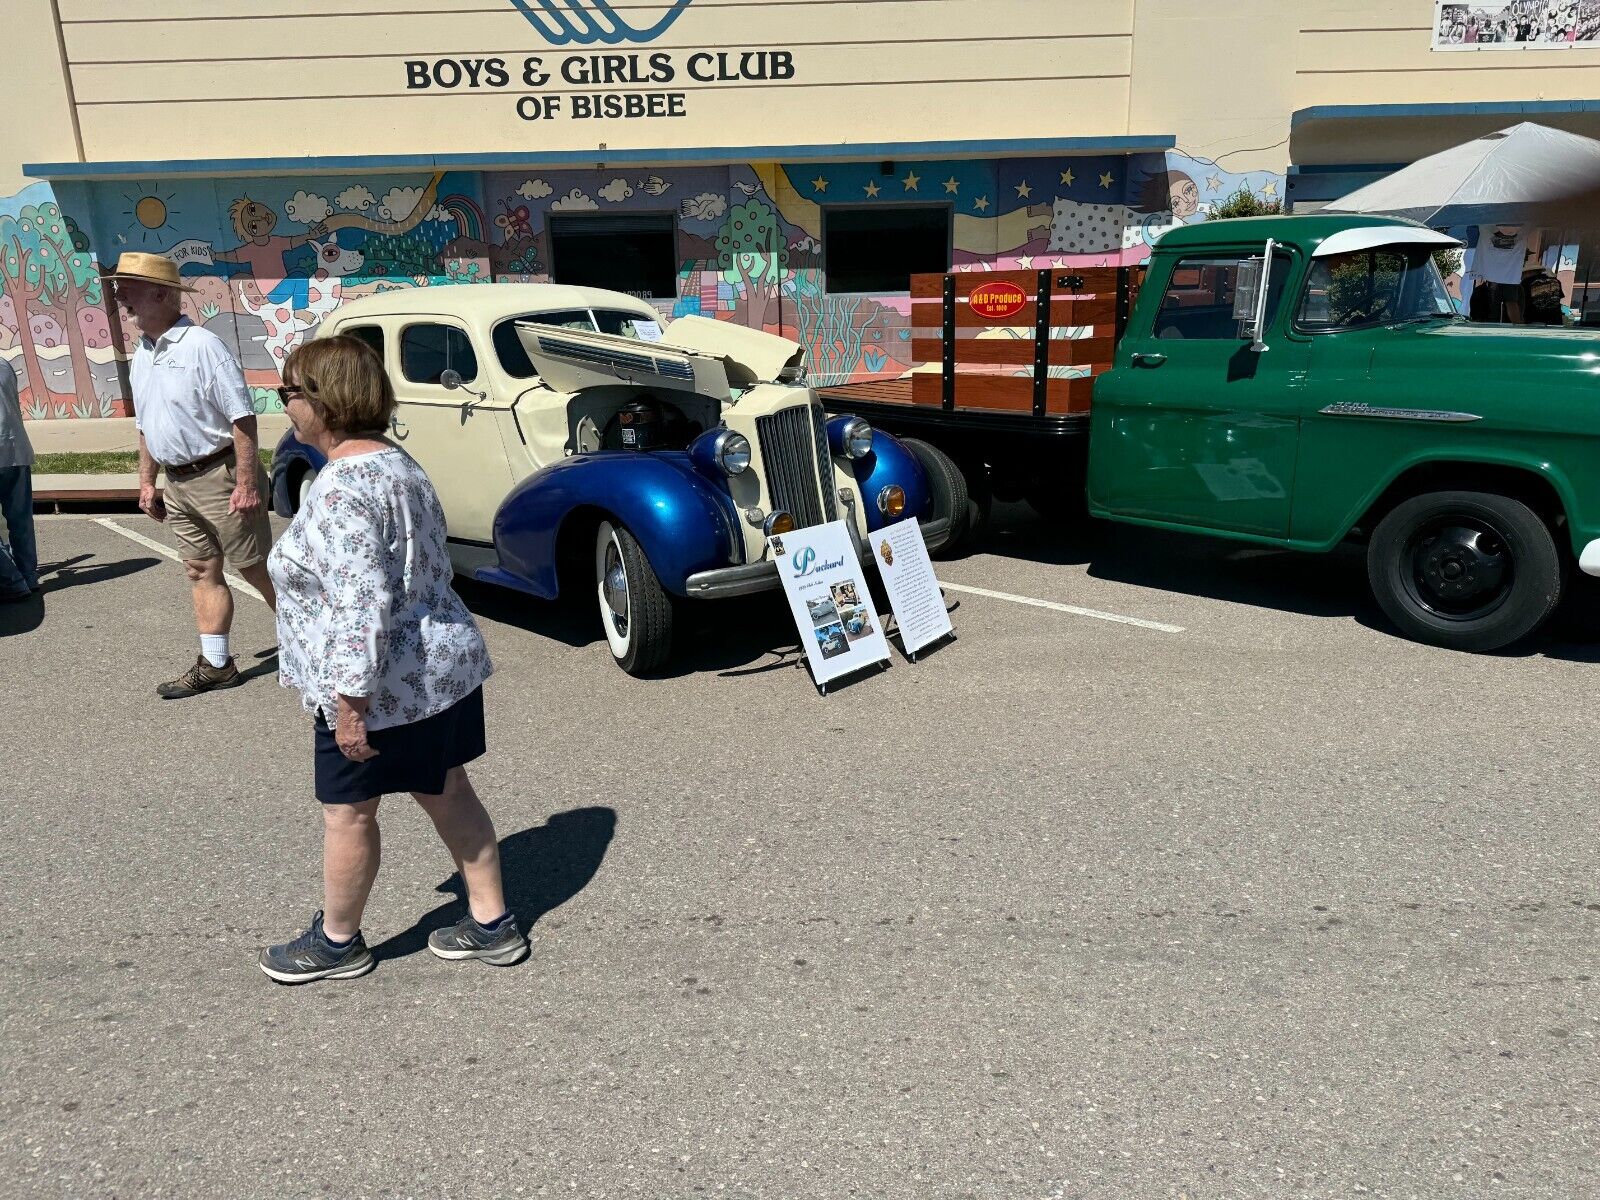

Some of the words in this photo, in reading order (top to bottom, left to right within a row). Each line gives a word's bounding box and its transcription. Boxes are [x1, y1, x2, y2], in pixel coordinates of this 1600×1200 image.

[404, 58, 510, 89] BOYS
[522, 56, 551, 87] &
[560, 53, 675, 84] GIRLS
[686, 51, 795, 82] CLUB
[516, 96, 561, 121] OF
[570, 93, 687, 119] BISBEE
[174, 247, 190, 260] FOR
[990, 293, 1022, 304] Produce
[793, 546, 844, 578] Packard
